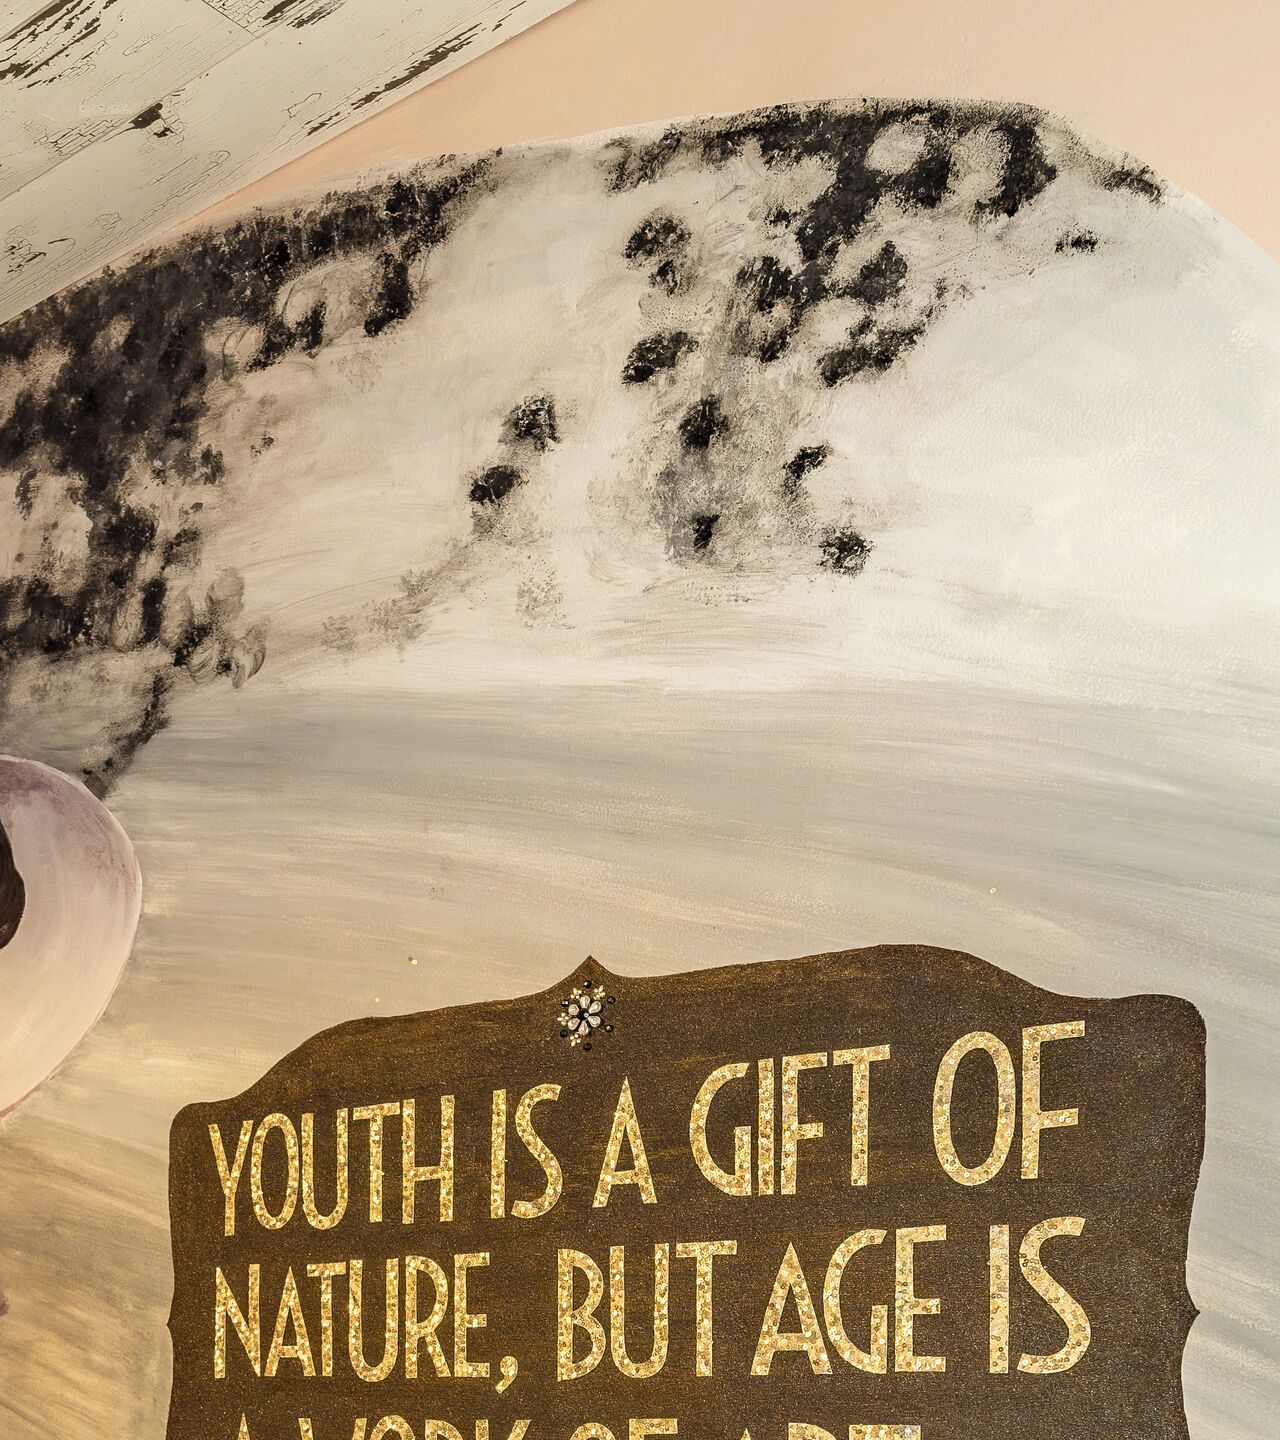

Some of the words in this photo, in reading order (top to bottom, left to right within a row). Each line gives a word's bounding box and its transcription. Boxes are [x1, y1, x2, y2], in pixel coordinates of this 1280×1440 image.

[208, 1094, 455, 1238] YOUTH
[490, 1083, 563, 1221] IS
[592, 1077, 658, 1208] A
[689, 1043, 891, 1197] GIFT
[931, 1020, 1087, 1186] OF
[213, 1250, 518, 1395] NATURE,
[556, 1239, 738, 1383] BUT
[750, 1224, 947, 1376] AGE
[987, 1216, 1091, 1376] IS
